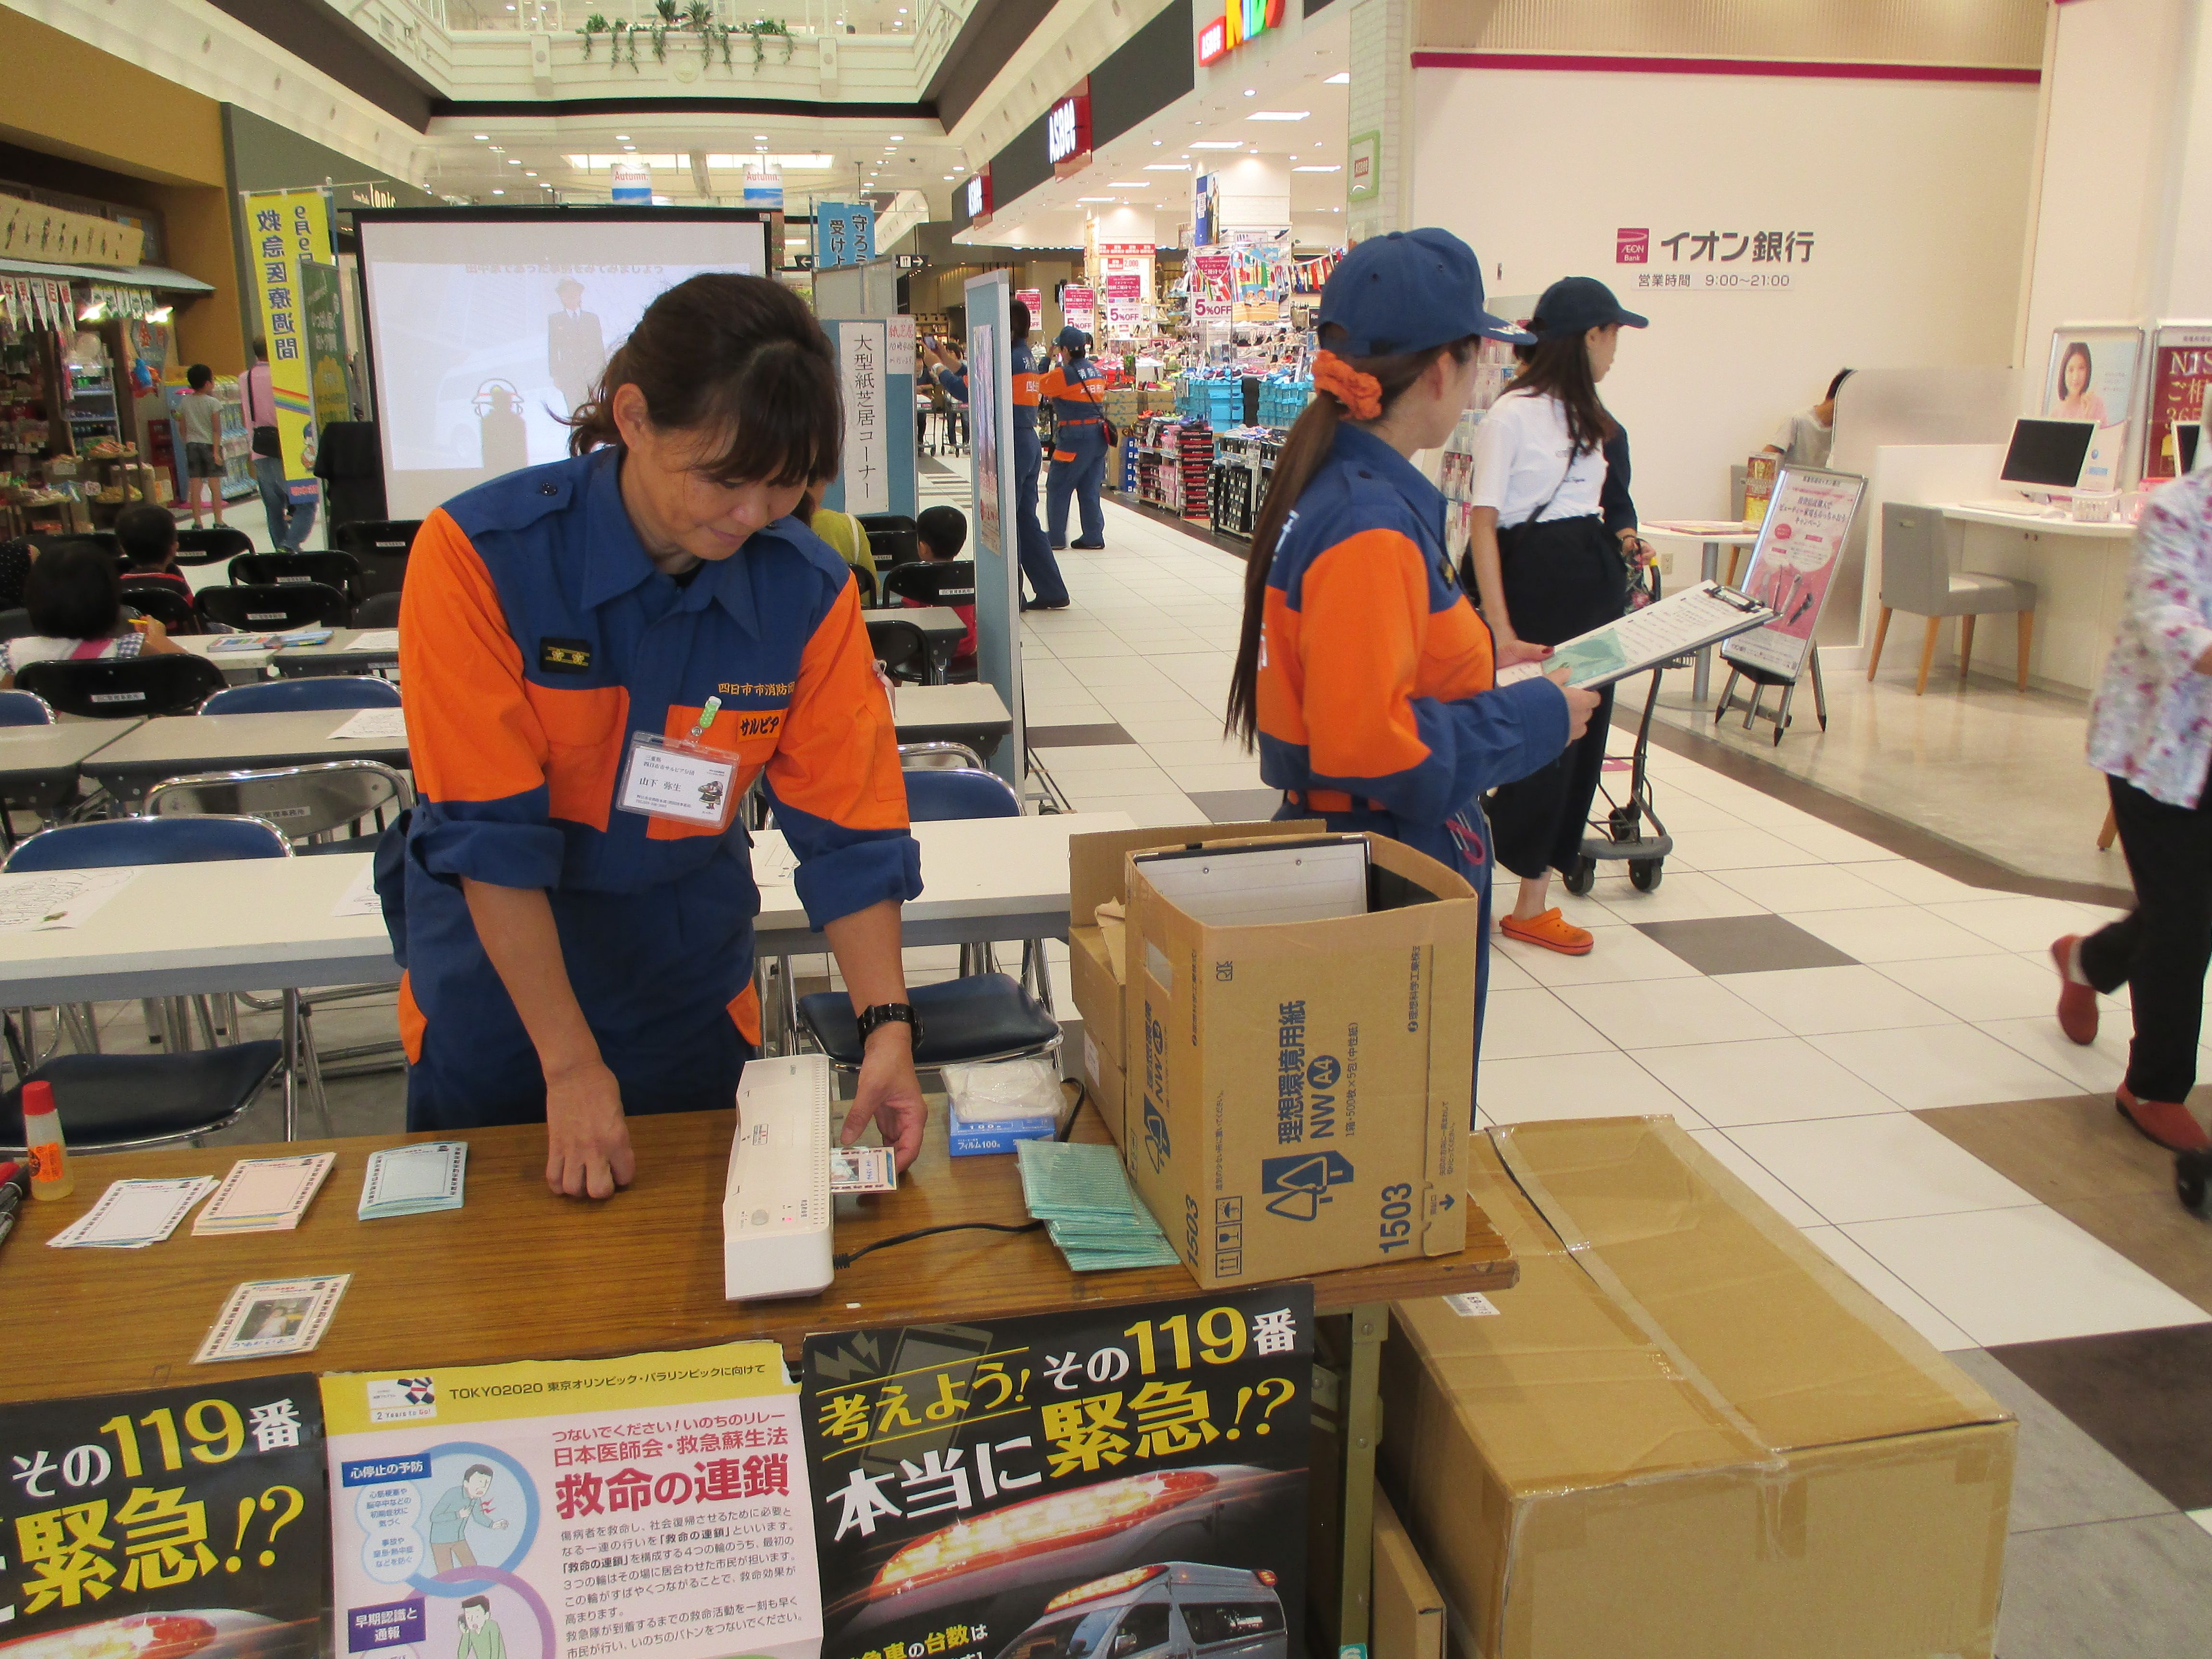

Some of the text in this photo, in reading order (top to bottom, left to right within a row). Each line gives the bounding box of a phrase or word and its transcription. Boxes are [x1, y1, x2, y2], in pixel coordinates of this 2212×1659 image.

[1049, 99, 1076, 164] ASBee
[1661, 230, 1814, 263] イオン銀行
[1638, 274, 1691, 287] 営業時間
[1110, 308, 1139, 321] 5%OFF
[1195, 299, 1232, 315] 5%OFF
[854, 334, 877, 499] 大型紙芝居コーナー
[718, 682, 796, 696] 四日市市消防団
[740, 716, 780, 736] サルビア
[639, 777, 682, 792] 山下 弥生
[644, 761, 695, 776] 四日市市サルビア分団
[1278, 1000, 1306, 1145] 理想環境用紙
[1310, 1058, 1335, 1139] NW A4
[958, 1142, 981, 1150] フィルム
[1185, 1194, 1200, 1269] 1503
[1379, 1182, 1412, 1253] 1503
[449, 1364, 765, 1401] TOKYO2020 東京オリンピック・パラリンピックに向けて
[817, 1306, 1297, 1445] 考えよう! その119番
[377, 1412, 383, 1420] 2
[553, 1413, 786, 1443] つないでください!いのちのリレー
[12, 1398, 301, 1499] その119番
[554, 1426, 789, 1468] 日本医師会・救急蘇生法
[826, 1377, 1297, 1540] 本当に緊急!?
[350, 1461, 423, 1479] 心停止の予防
[555, 1453, 791, 1520] 救命の連鎖
[379, 1519, 400, 1528] 気づく
[561, 1506, 792, 1542] 傷病者を救命し、社会復帰させるために必要と
[562, 1522, 795, 1557] なる一連の行いを「救命の連鎖」といいます。
[0, 1484, 305, 1622] 緊急!?
[381, 1537, 405, 1546] 事故や
[565, 1567, 796, 1608] この輪がすばやくつながることで、救命効果が
[355, 1607, 418, 1628] 早期認識と
[565, 1606, 625, 1626] 高まります。
[566, 1596, 798, 1642] 救急隊が到着するまでの救命活動を一刻も早く
[375, 1626, 400, 1642] 通報
[567, 1614, 804, 1659] 市民が行い、いのちのバトンをつないでください。
[851, 1623, 989, 1659] 車の台数は
